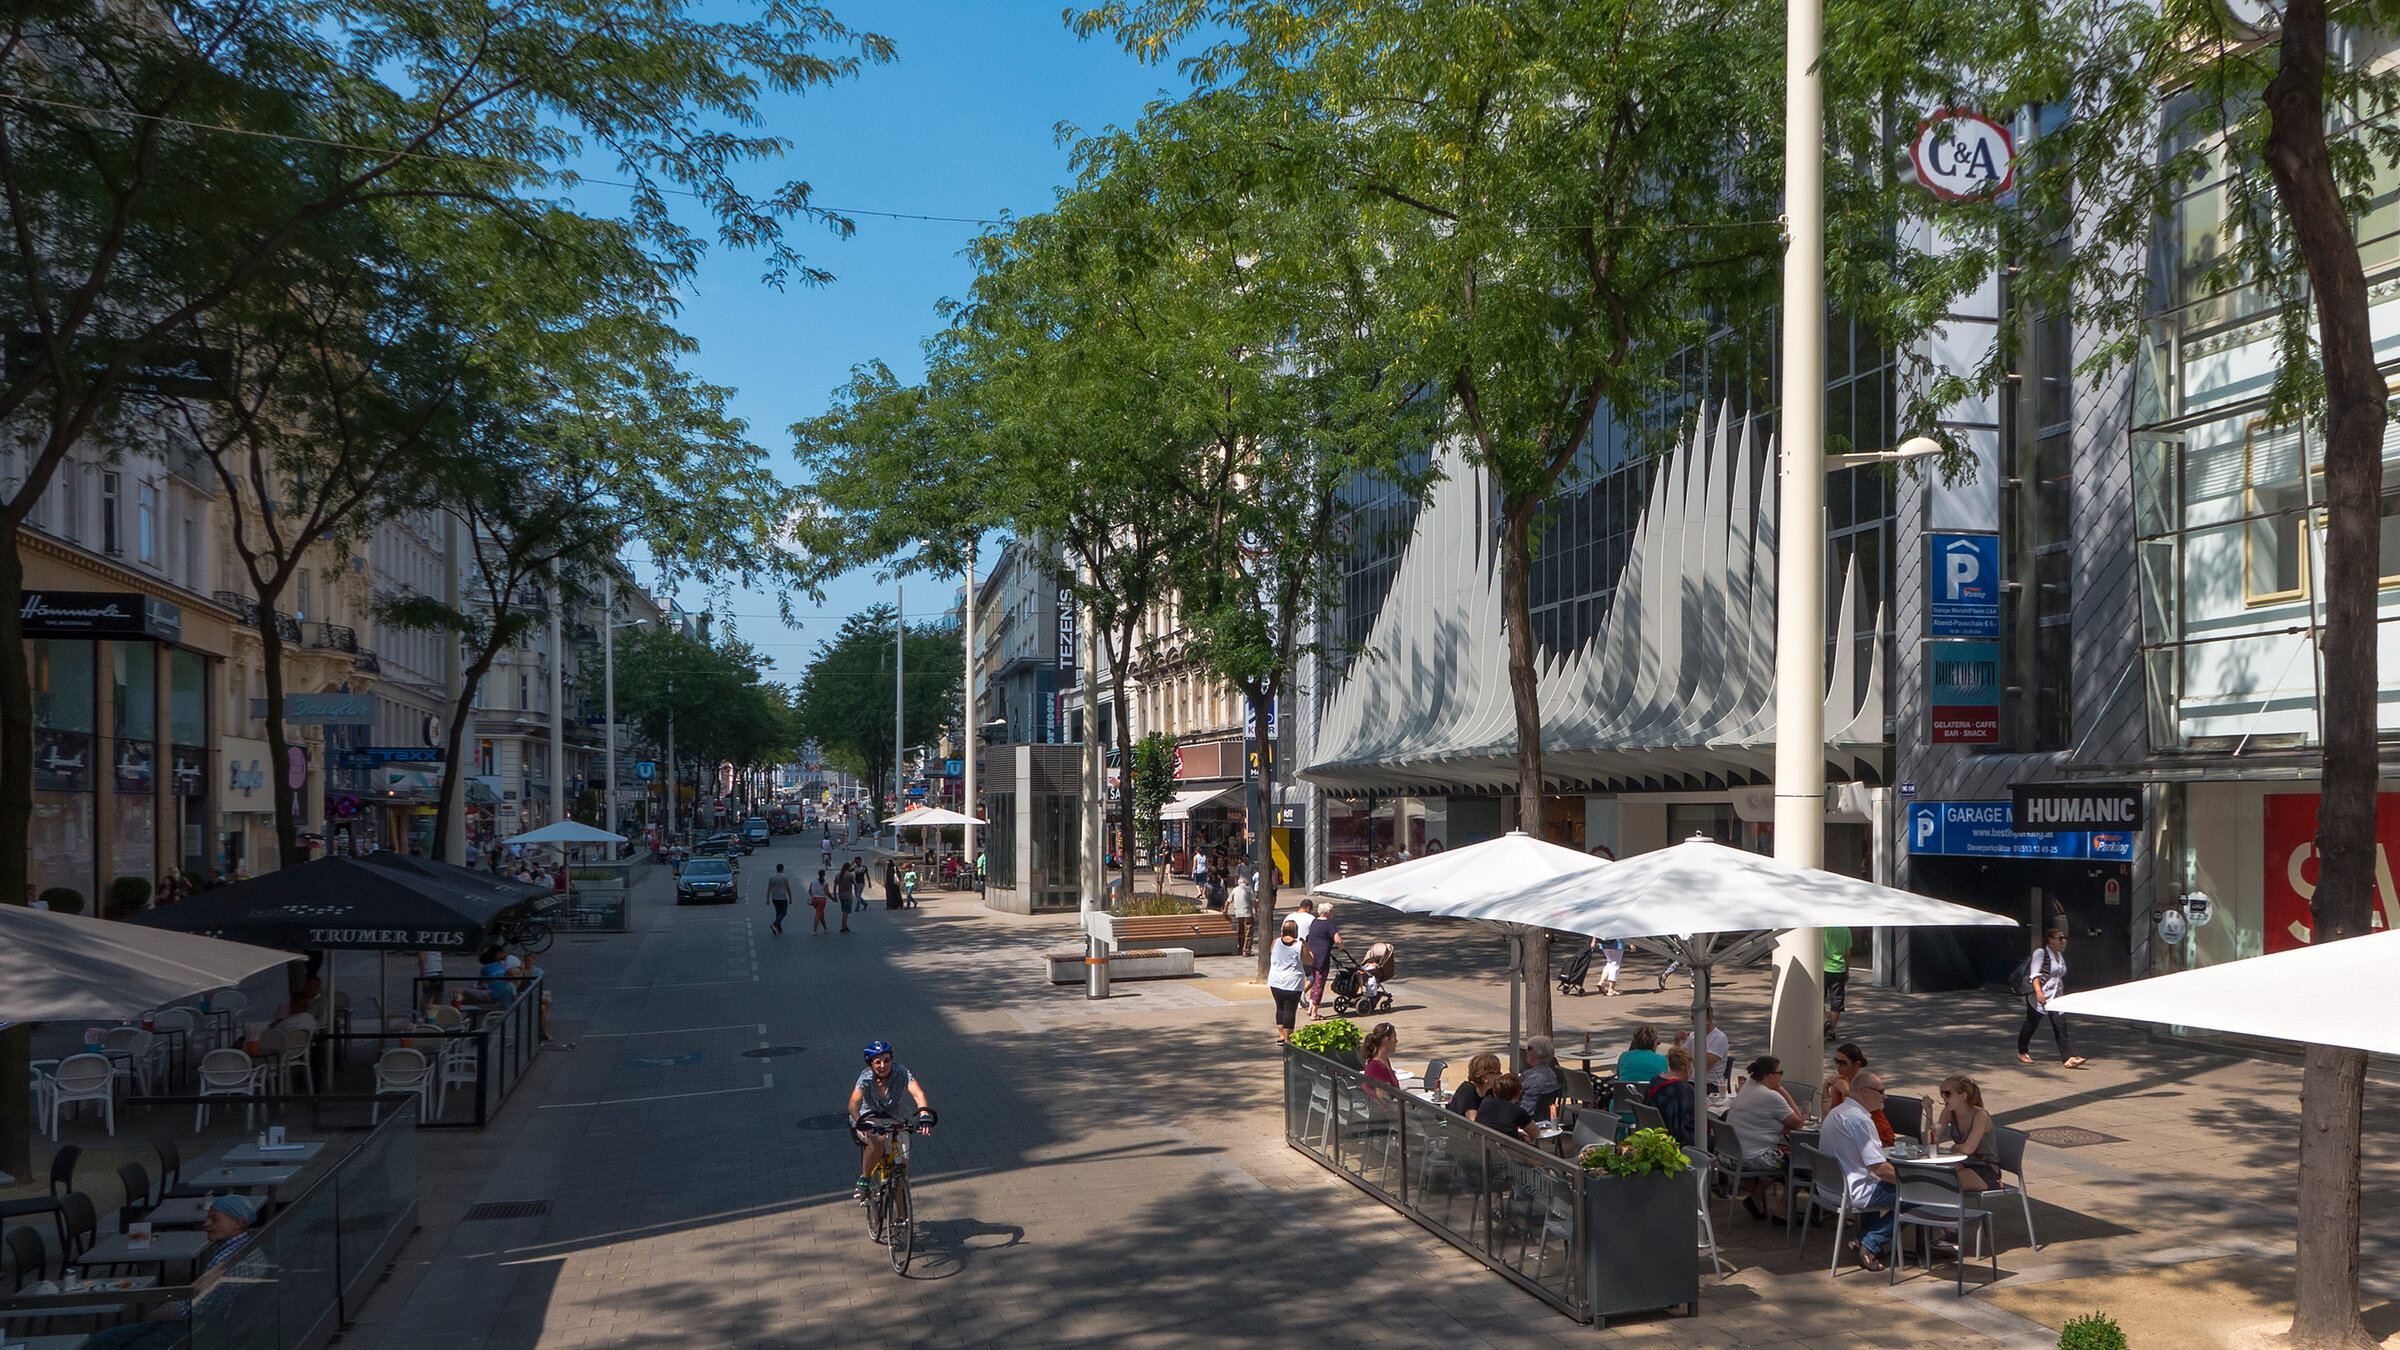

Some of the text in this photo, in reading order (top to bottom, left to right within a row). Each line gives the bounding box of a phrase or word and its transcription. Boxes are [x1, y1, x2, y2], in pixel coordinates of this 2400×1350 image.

[1928, 134, 2000, 181] C&A
[1946, 553, 1980, 600] P
[1935, 660, 1995, 686] BORTOLOTTI
[1933, 720, 1972, 729] GELATERIA
[1944, 729, 1959, 737] BAR
[639, 764, 653, 777] U
[950, 763, 961, 776] U
[1946, 807, 2003, 823] GARAGE
[2027, 797, 2136, 824] HUMANIC
[1916, 817, 1934, 848] P
[2097, 841, 2129, 855] Parking
[309, 928, 465, 946] TRUMER PILS
